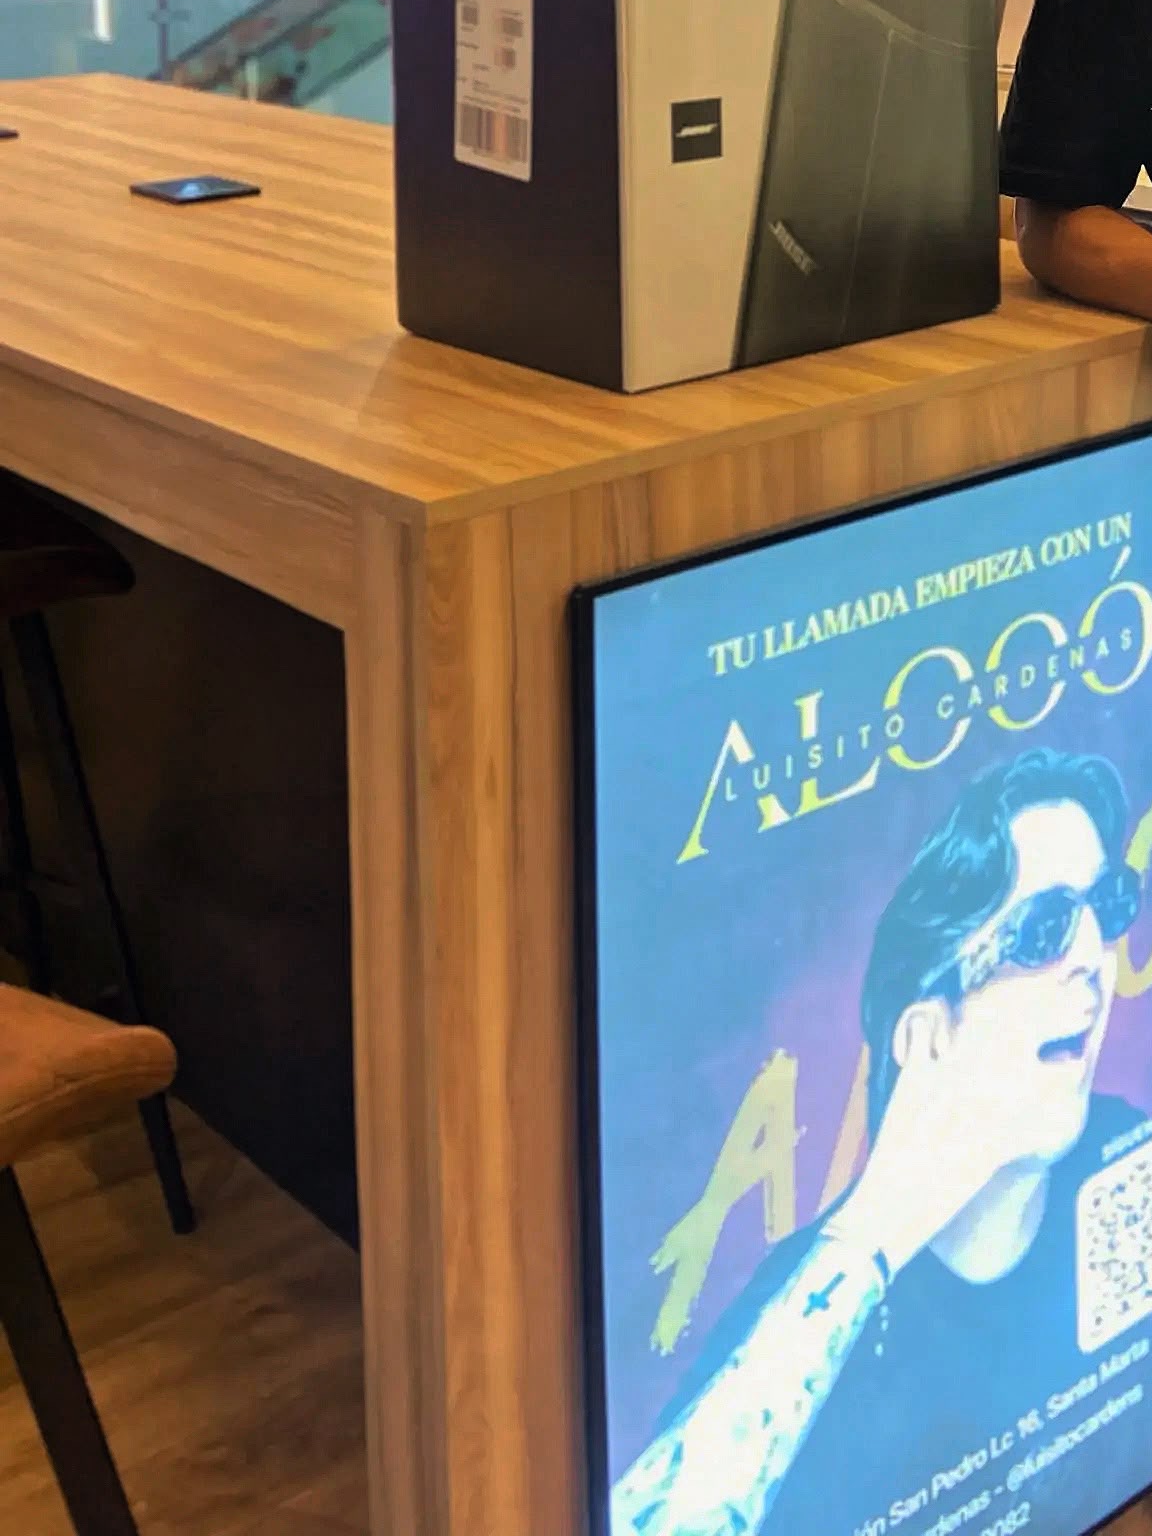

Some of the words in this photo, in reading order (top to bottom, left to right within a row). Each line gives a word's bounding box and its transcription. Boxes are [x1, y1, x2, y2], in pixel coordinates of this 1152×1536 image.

[708, 631, 756, 675] TU
[763, 585, 908, 660] LLAMADA
[915, 546, 1035, 609] EMPIEZA
[1040, 524, 1091, 567] CON
[1096, 512, 1132, 549] UN
[725, 714, 905, 802] LUISITO
[936, 629, 1133, 719] CARDENAS
[888, 1488, 928, 1526] San
[930, 1447, 988, 1499] Pedro
